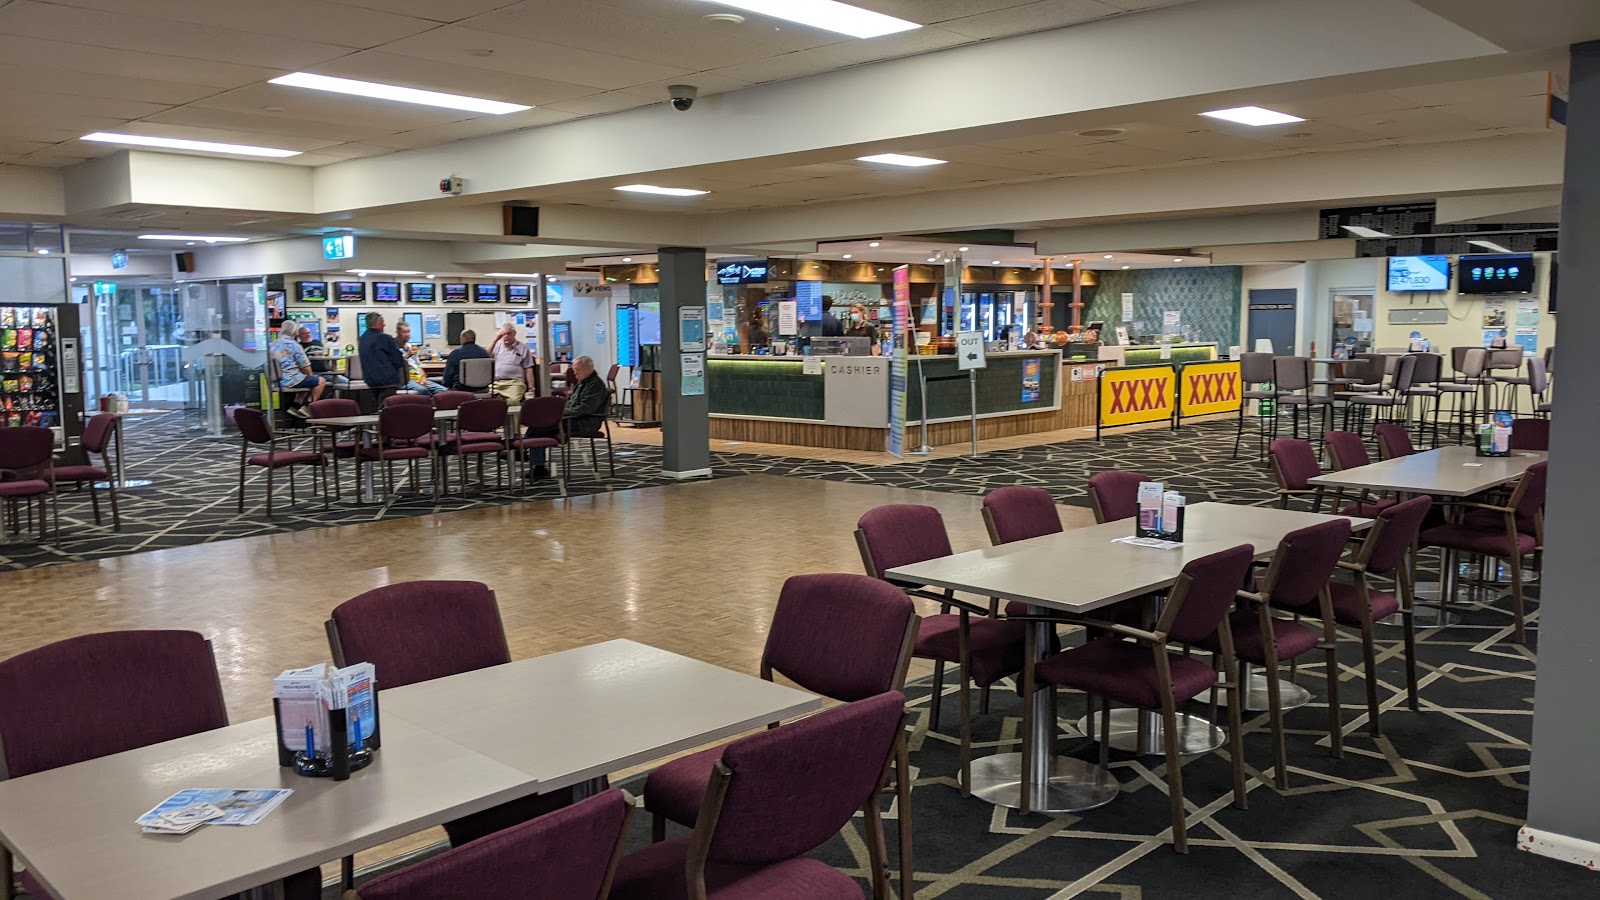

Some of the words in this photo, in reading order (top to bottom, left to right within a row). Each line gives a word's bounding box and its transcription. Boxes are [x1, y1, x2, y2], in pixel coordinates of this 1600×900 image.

[961, 338, 979, 346] OUT
[830, 365, 881, 375] CASHIER
[1110, 377, 1168, 415] XXXX
[1188, 371, 1237, 406] XXXX
